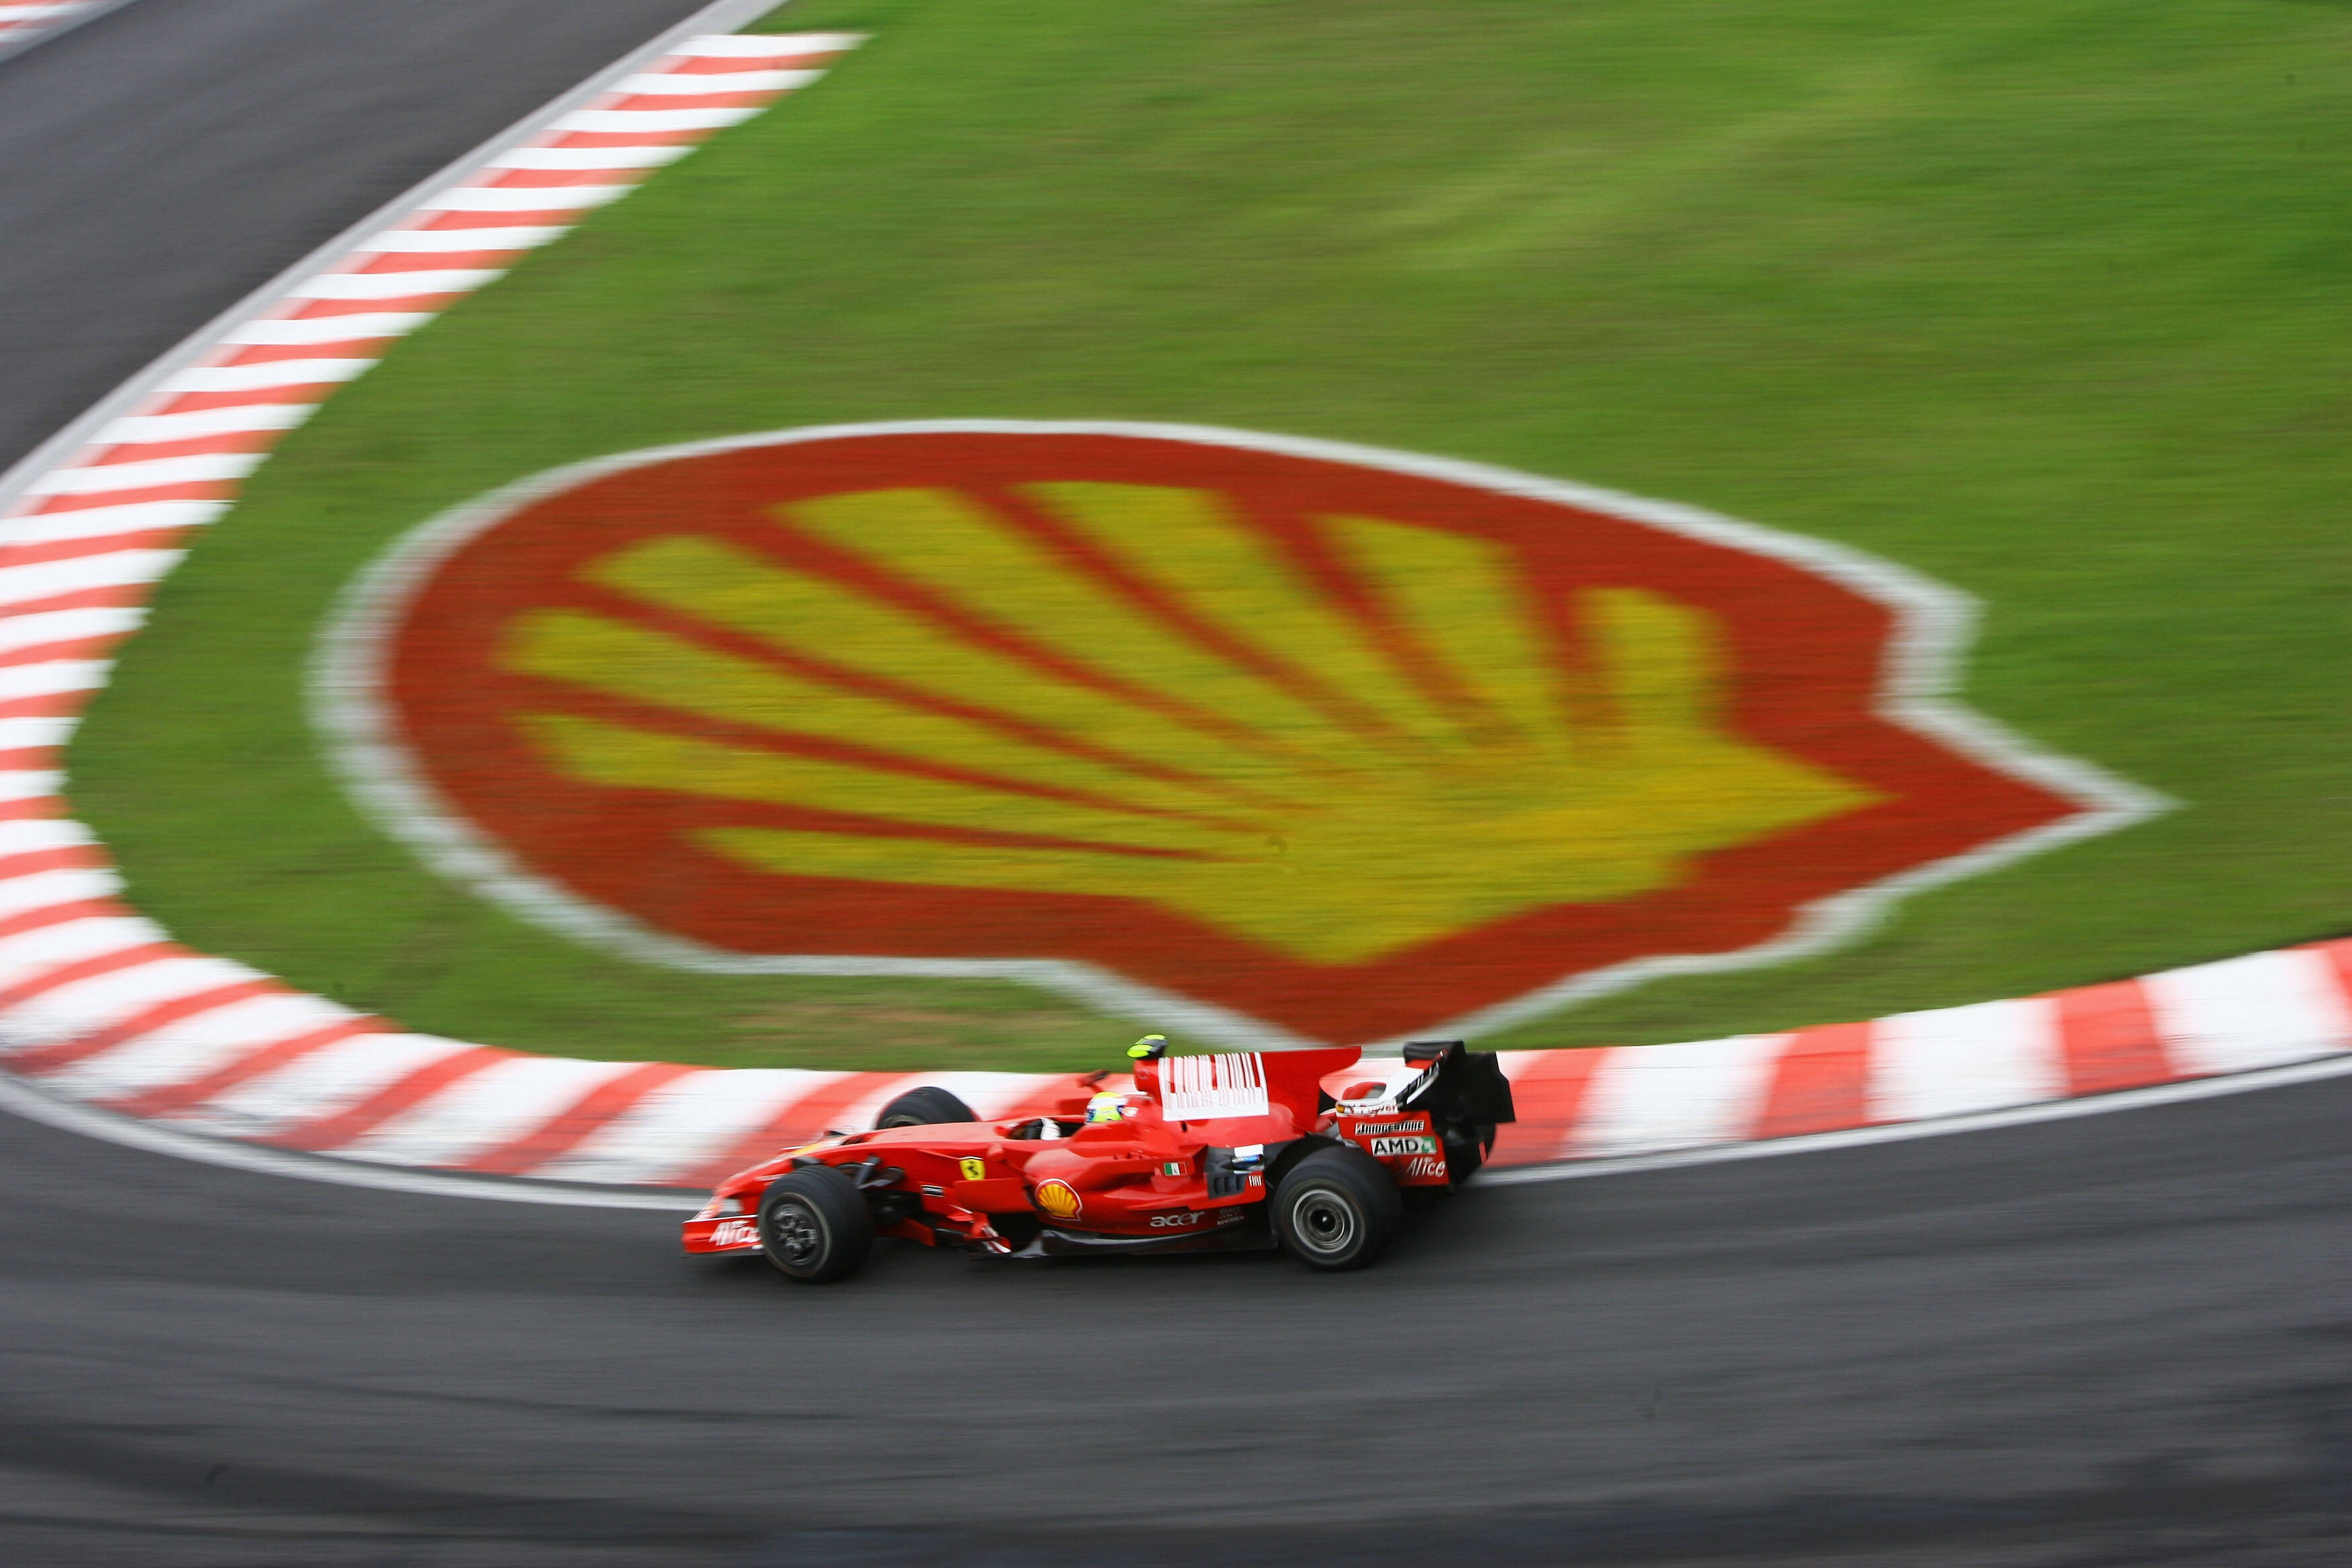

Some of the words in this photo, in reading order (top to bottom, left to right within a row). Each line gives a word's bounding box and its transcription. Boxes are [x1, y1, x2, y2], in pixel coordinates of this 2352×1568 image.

[1355, 1120, 1424, 1135] BRIDGESTONE
[1374, 1139, 1419, 1155] AMD
[1407, 1157, 1446, 1177] Alice
[1150, 1212, 1205, 1227] acer
